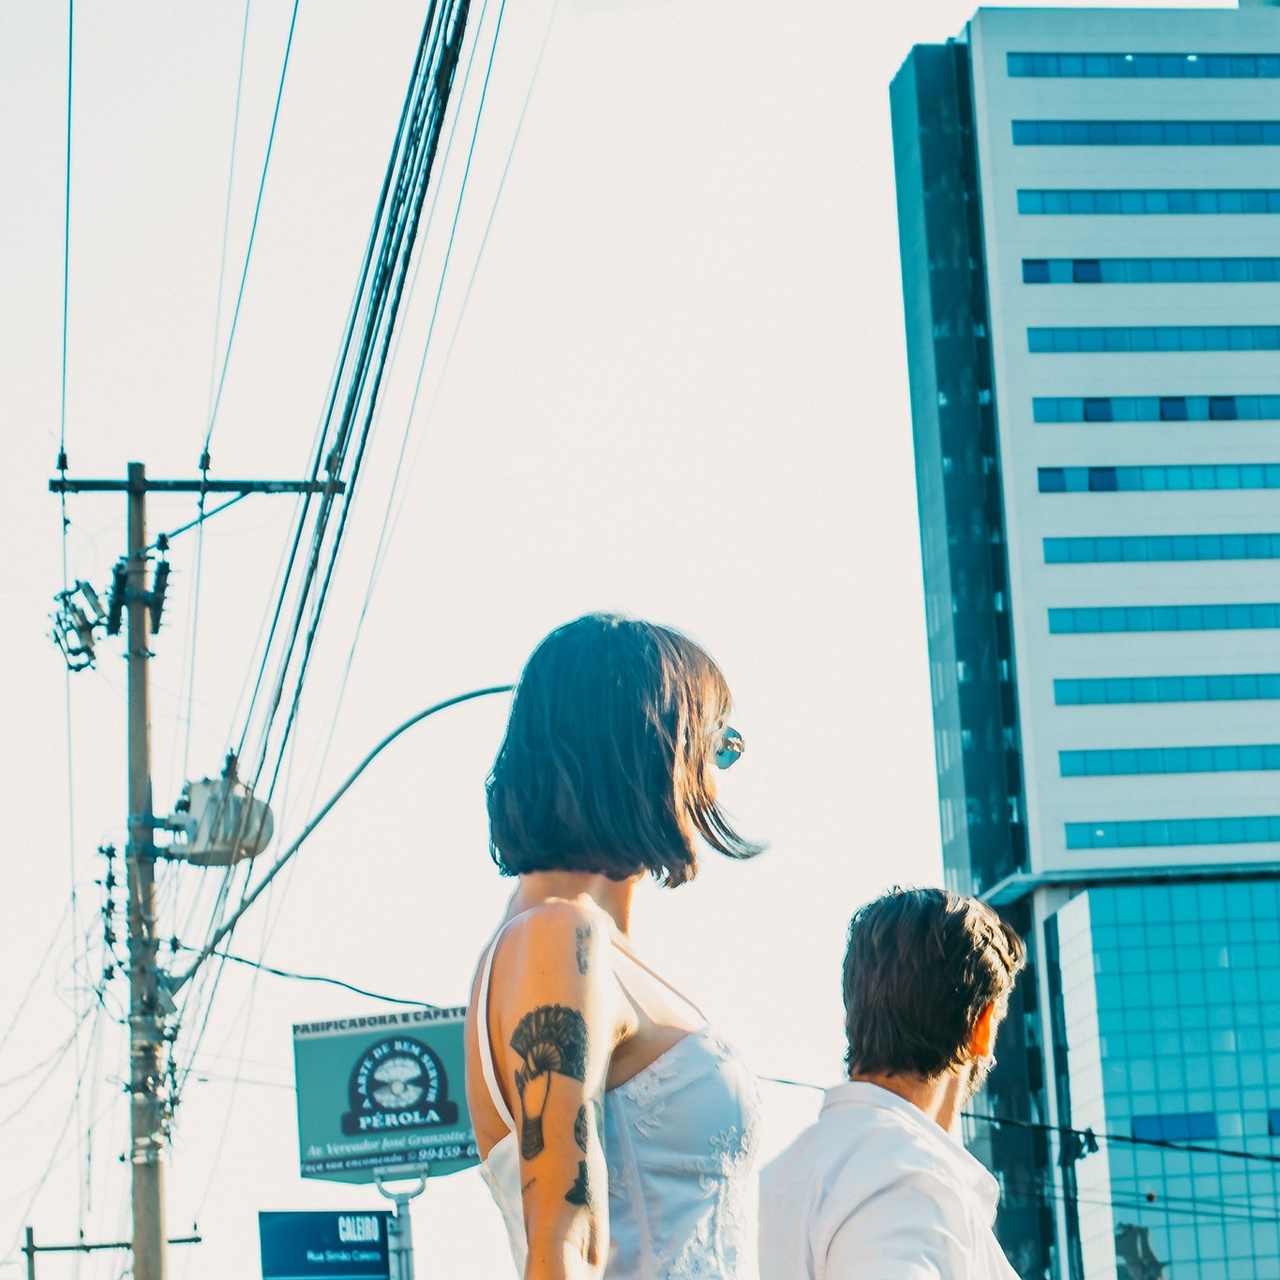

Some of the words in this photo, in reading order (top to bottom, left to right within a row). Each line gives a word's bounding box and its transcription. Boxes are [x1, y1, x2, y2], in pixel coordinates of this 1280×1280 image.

[292, 1014, 398, 1034] PANIFICADORA
[401, 1012, 409, 1023] E
[357, 1057, 374, 1096] ARTE
[372, 1042, 391, 1060] DE
[394, 1040, 422, 1056] BEM
[420, 1053, 439, 1103] SERVIR
[358, 1108, 440, 1130] PÉROLA
[326, 1137, 379, 1155] Vereador
[381, 1132, 407, 1150] José
[325, 1160, 343, 1170] sua
[338, 1215, 379, 1242] CALEIRO
[307, 1250, 324, 1262] Rua
[325, 1250, 351, 1262] Simão
[352, 1250, 380, 1262] Caleiro
